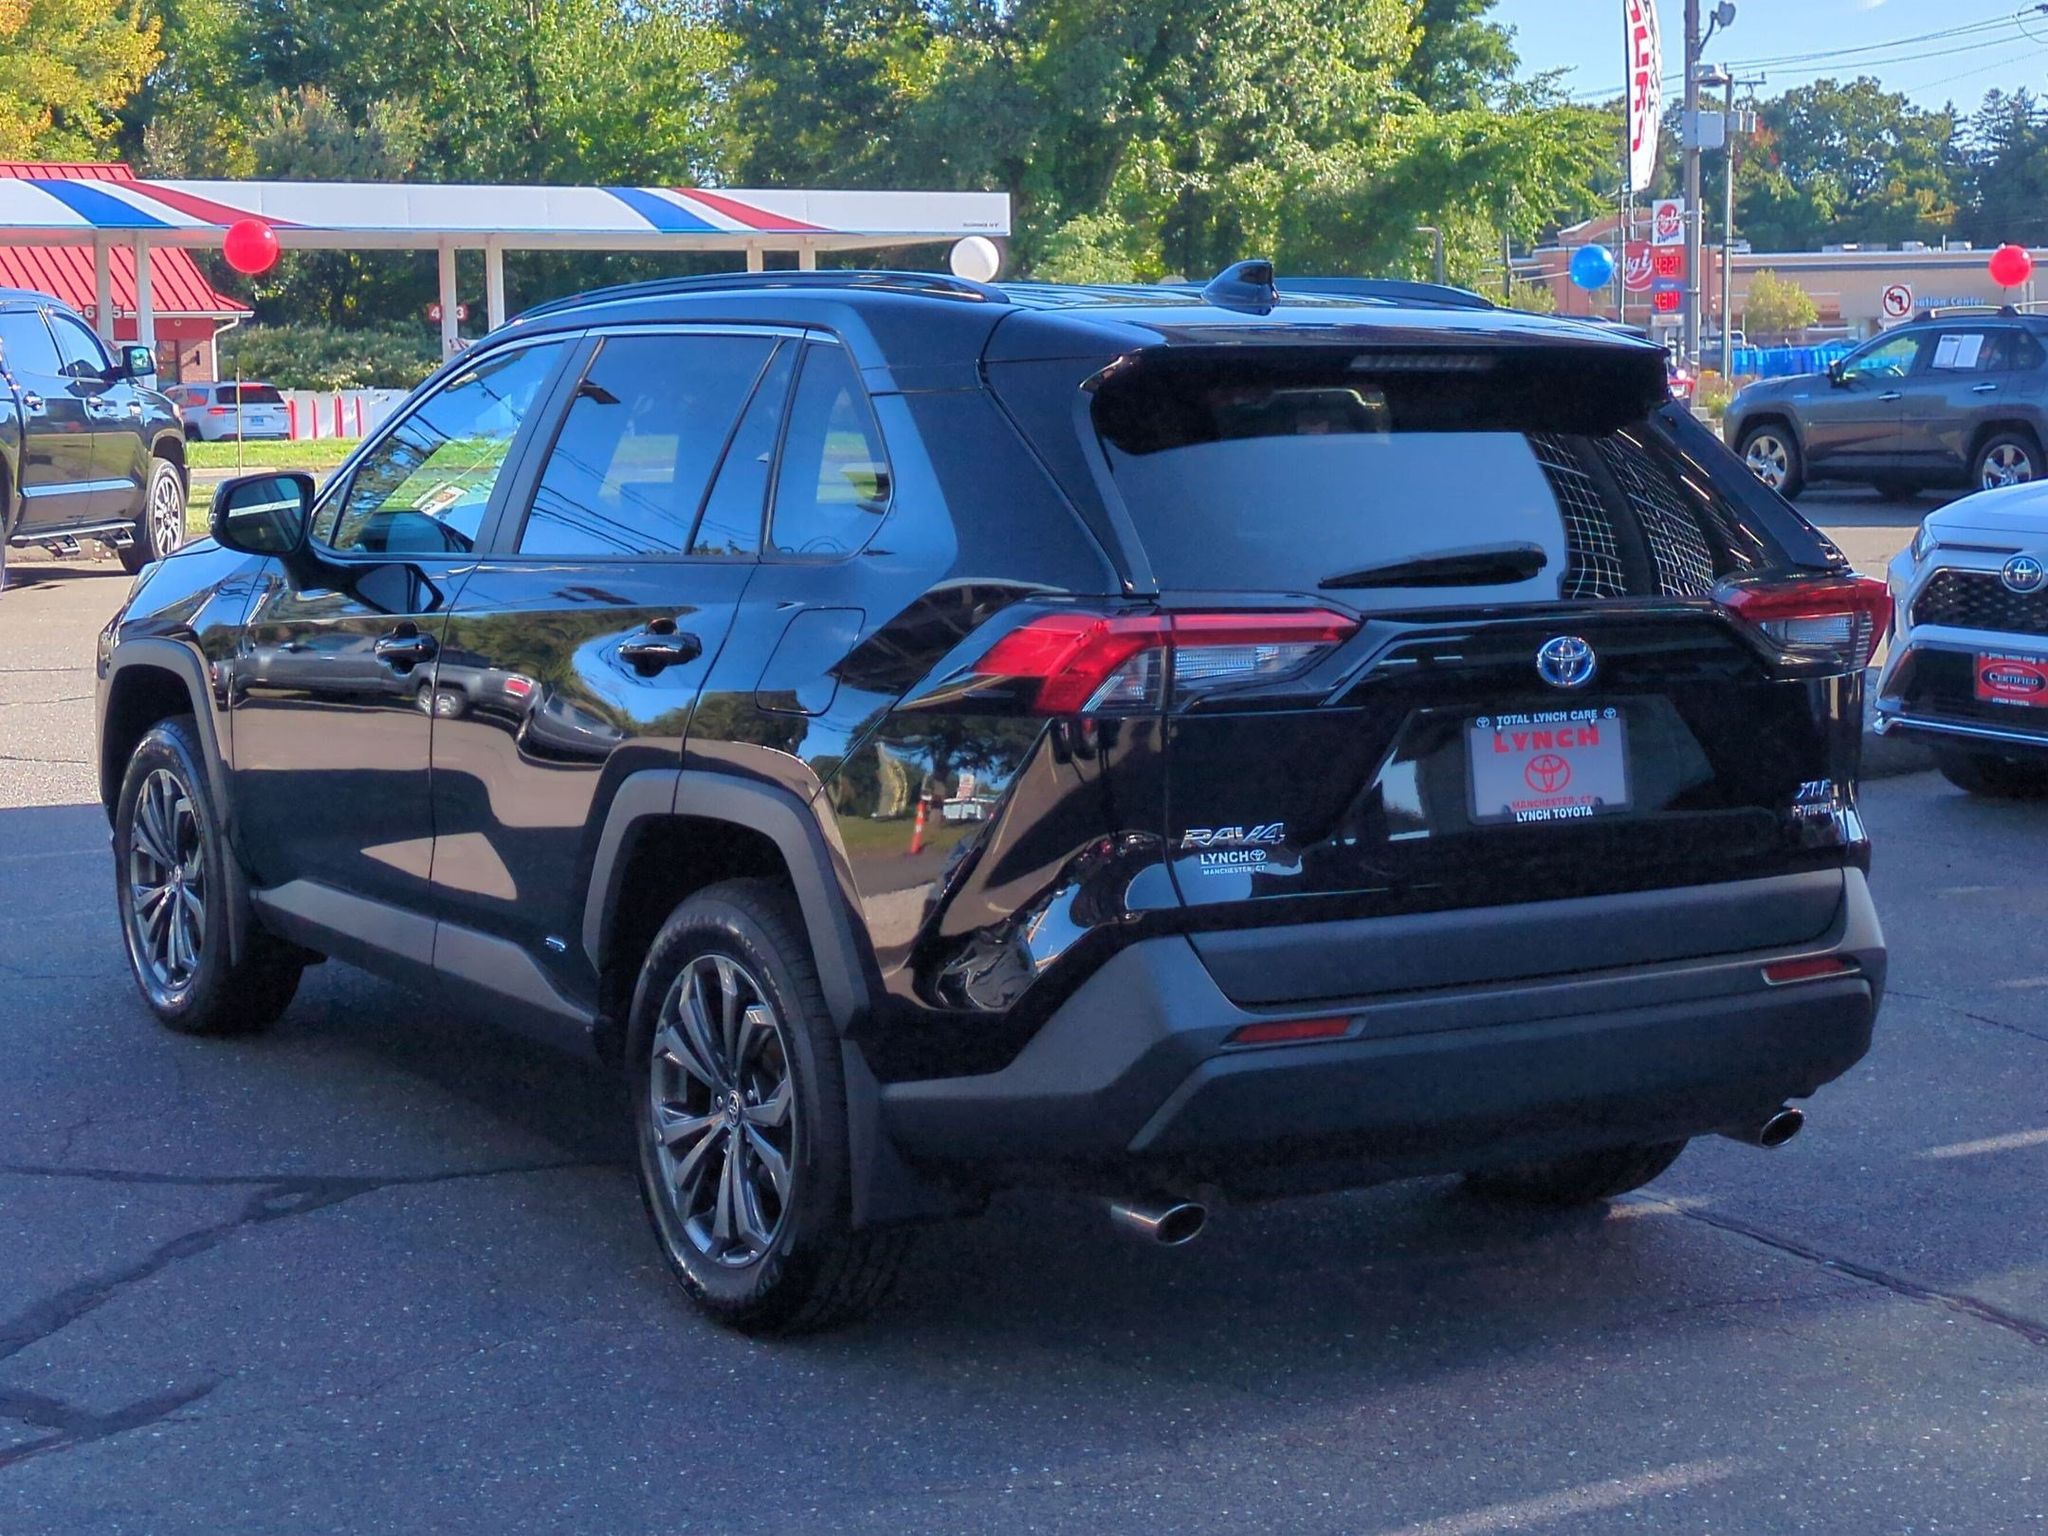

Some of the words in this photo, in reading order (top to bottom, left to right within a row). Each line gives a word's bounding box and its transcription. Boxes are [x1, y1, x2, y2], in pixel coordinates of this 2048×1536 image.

[84, 305, 95, 319] 6
[112, 305, 122, 319] 5
[431, 306, 440, 319] 4
[456, 306, 464, 320] 3
[1497, 713, 1530, 726] TOTAL
[1533, 711, 1567, 724] LYNCH
[1570, 709, 1598, 721] CARE
[1493, 725, 1600, 753] LYNCH
[1516, 808, 1551, 823] LYNCH
[1552, 805, 1593, 819] TOYOTA
[1180, 822, 1286, 849] RAV4
[1200, 851, 1249, 865] LYNCH
